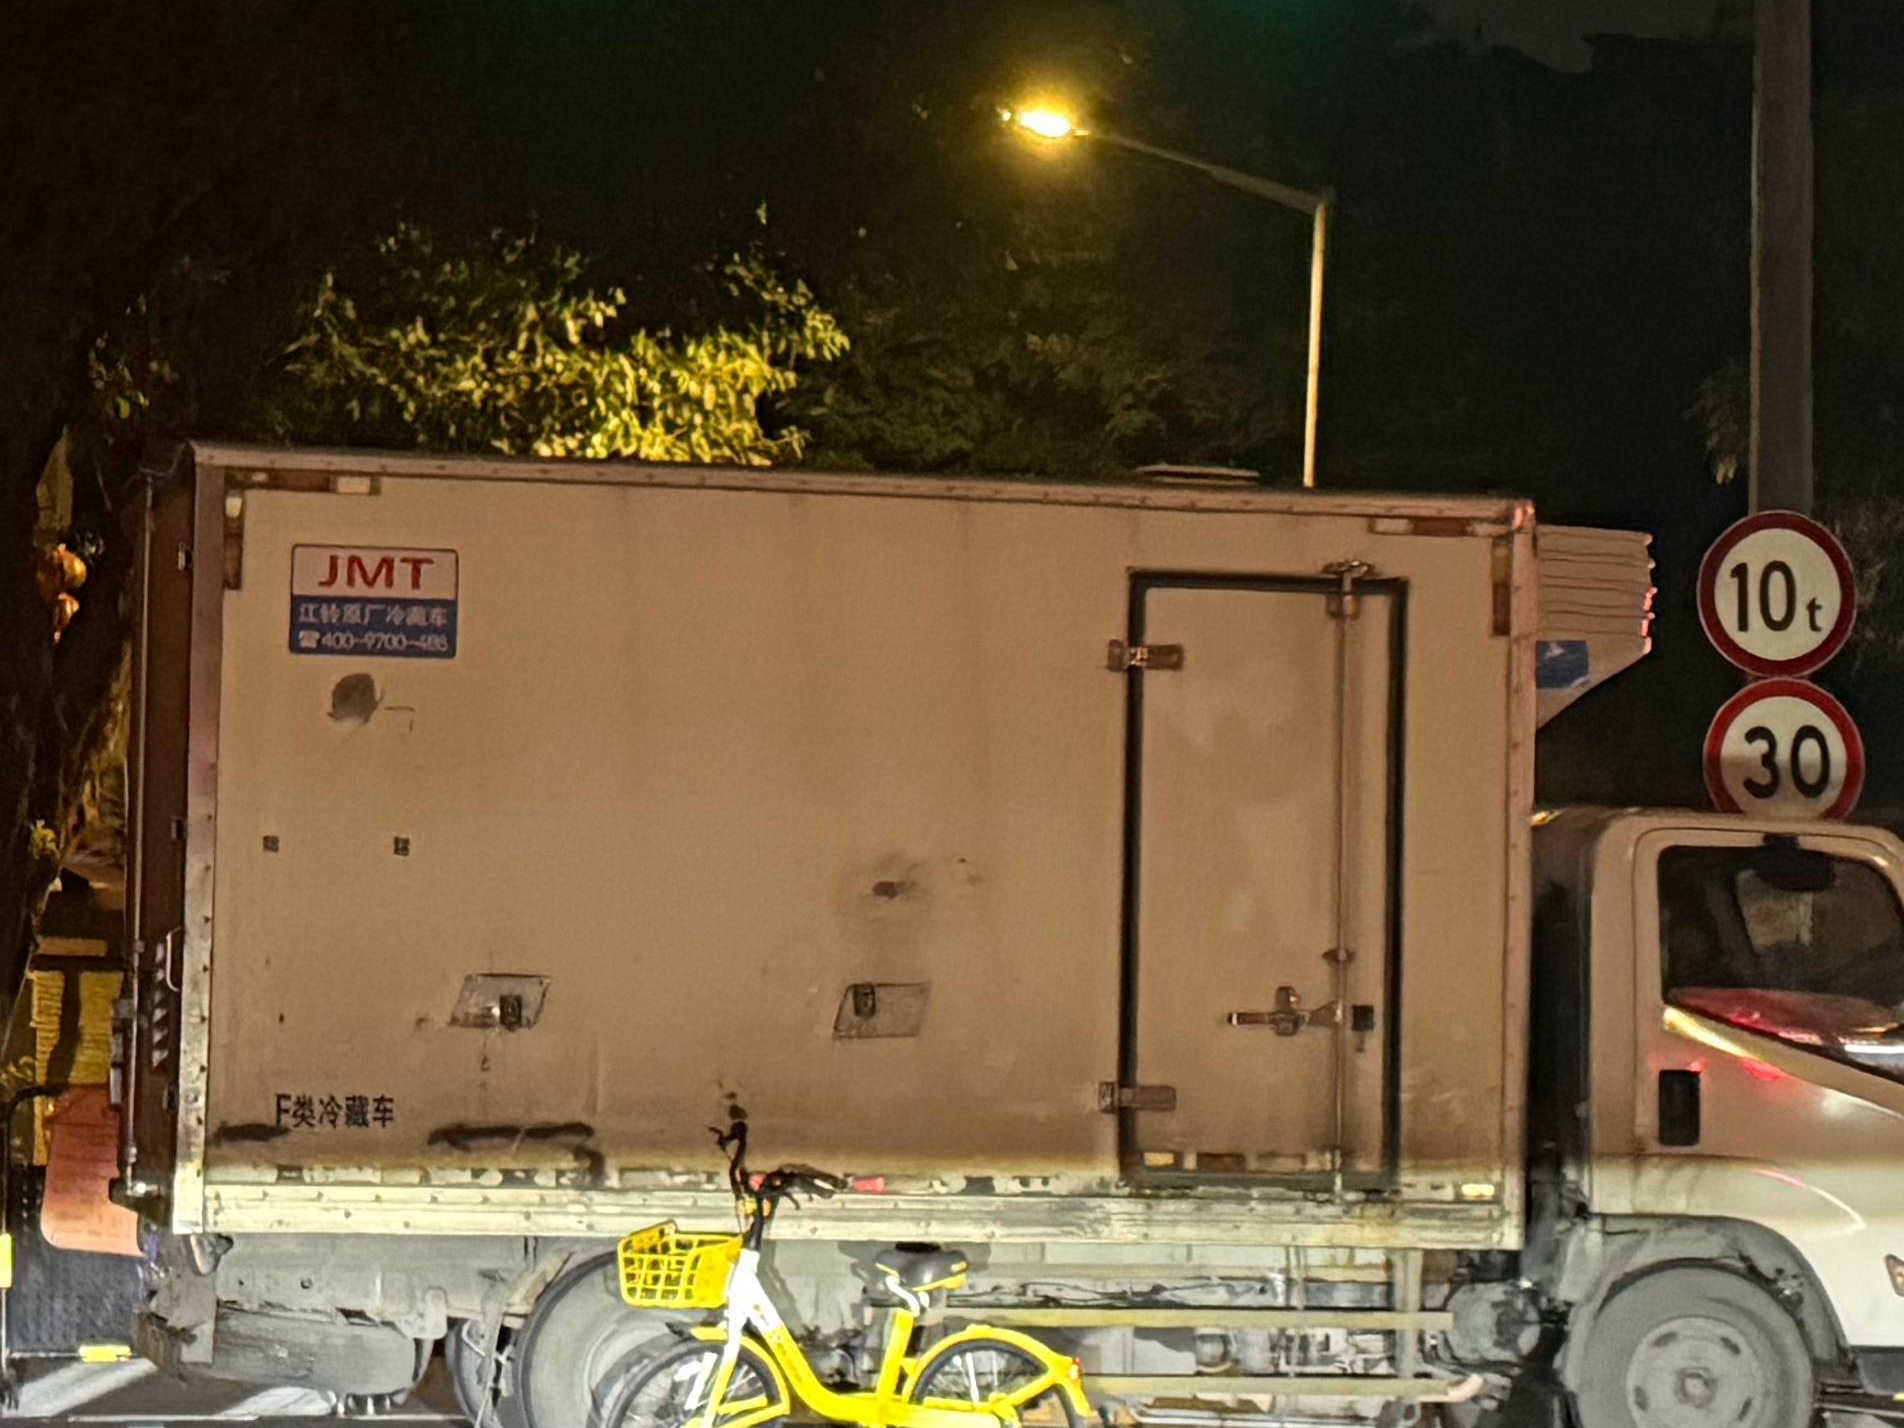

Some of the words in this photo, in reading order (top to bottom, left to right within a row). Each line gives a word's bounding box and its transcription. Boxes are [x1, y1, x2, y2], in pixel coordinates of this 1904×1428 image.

[318, 554, 435, 591] JMT
[1743, 724, 1831, 800] 30
[275, 1092, 395, 1130] F类冷藏车
